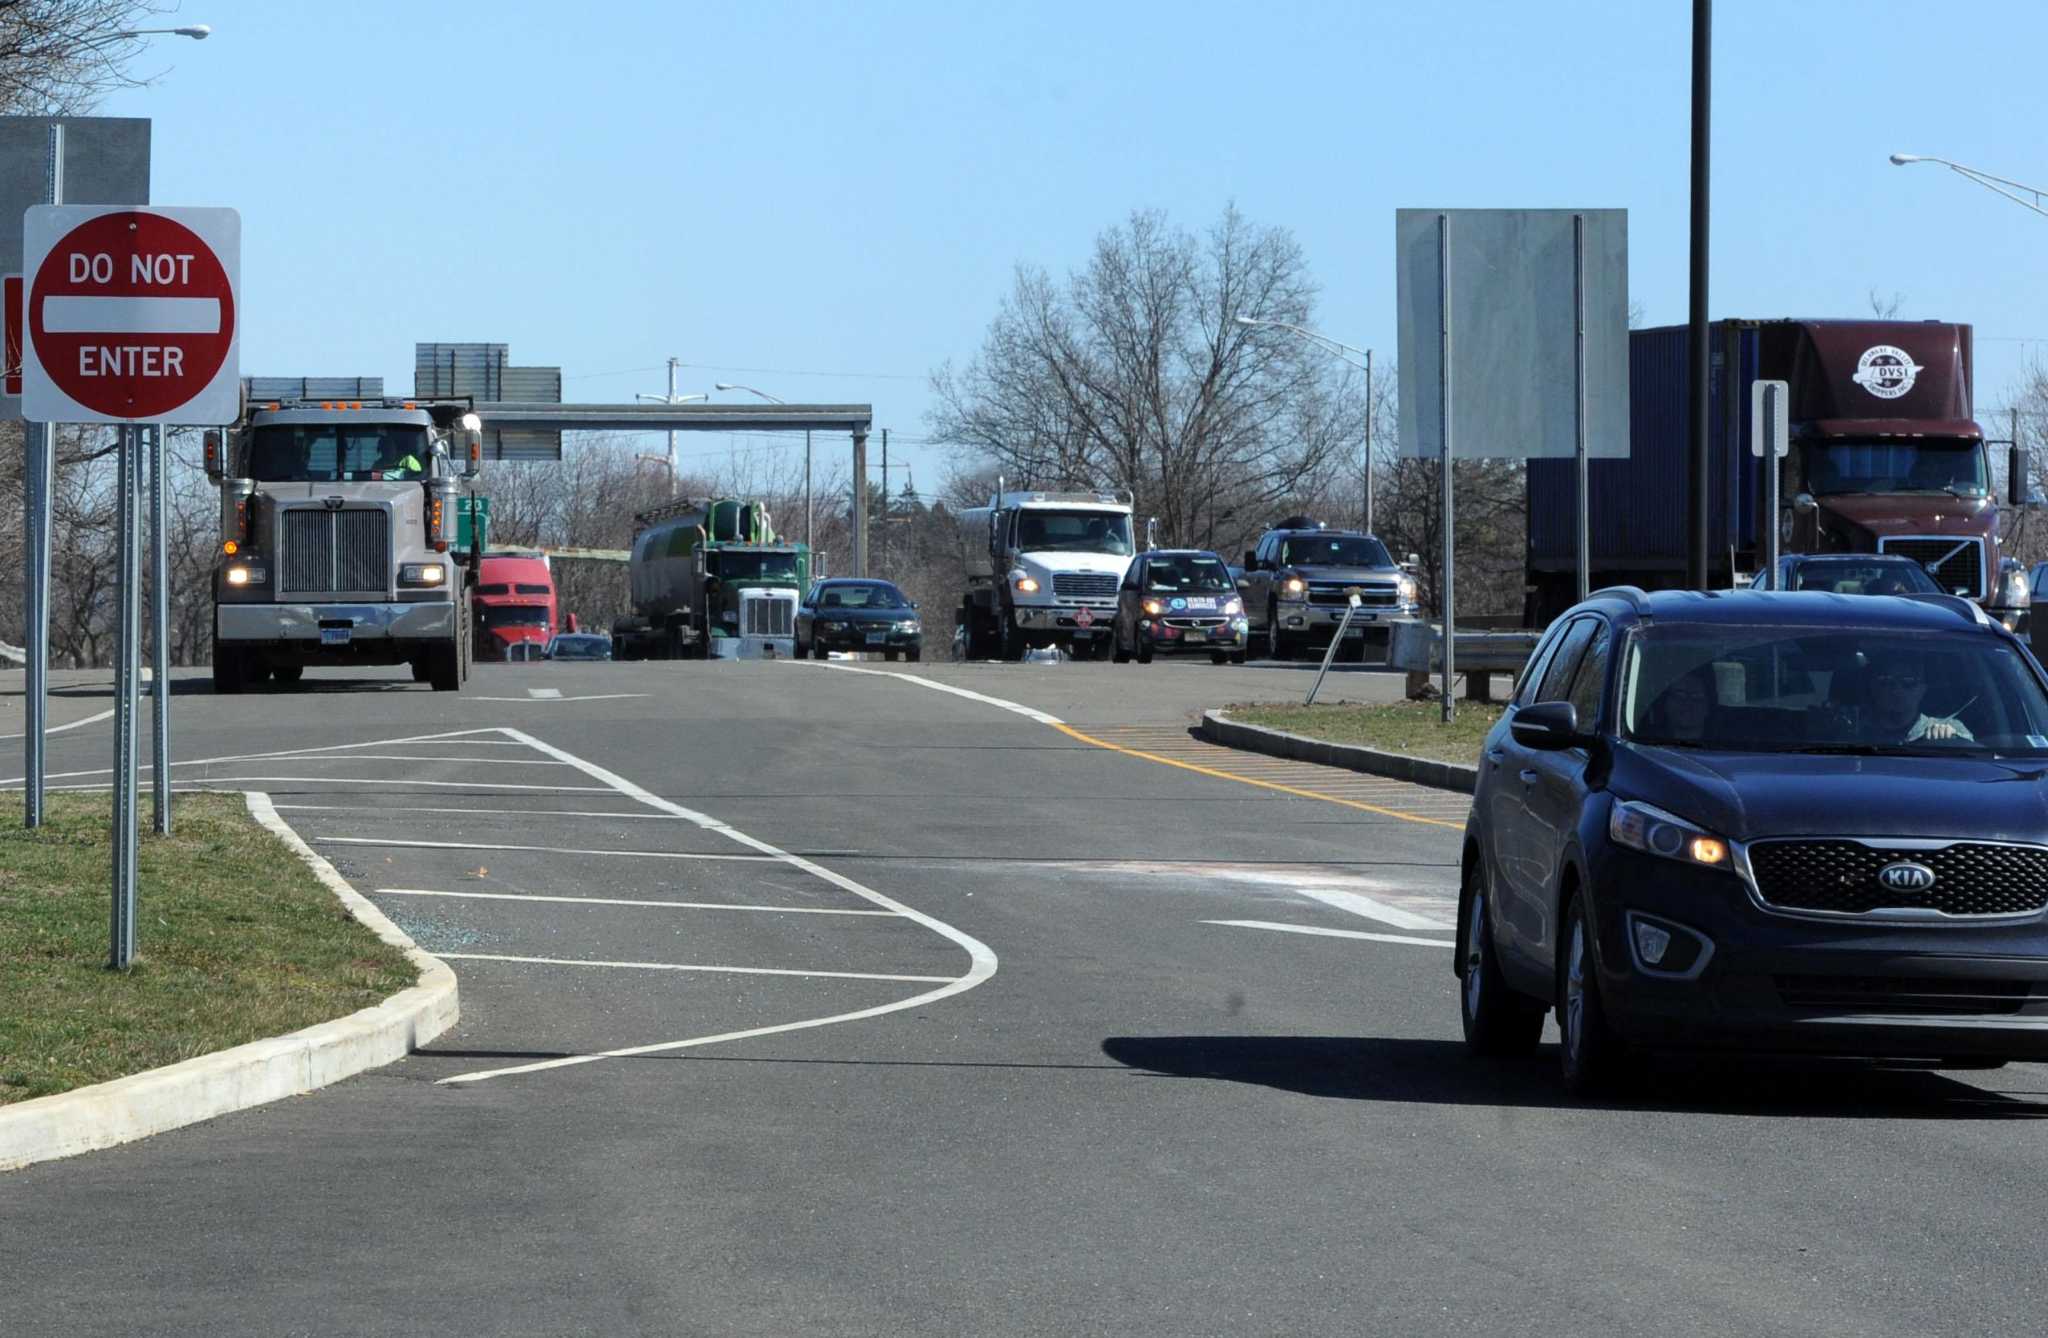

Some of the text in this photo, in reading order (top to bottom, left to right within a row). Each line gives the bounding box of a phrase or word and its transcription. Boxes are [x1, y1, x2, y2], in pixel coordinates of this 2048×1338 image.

[69, 253, 195, 285] DO NOT
[79, 346, 184, 377] ENTER
[1879, 367, 1908, 377] DVSI
[1888, 870, 1925, 886] KIA
